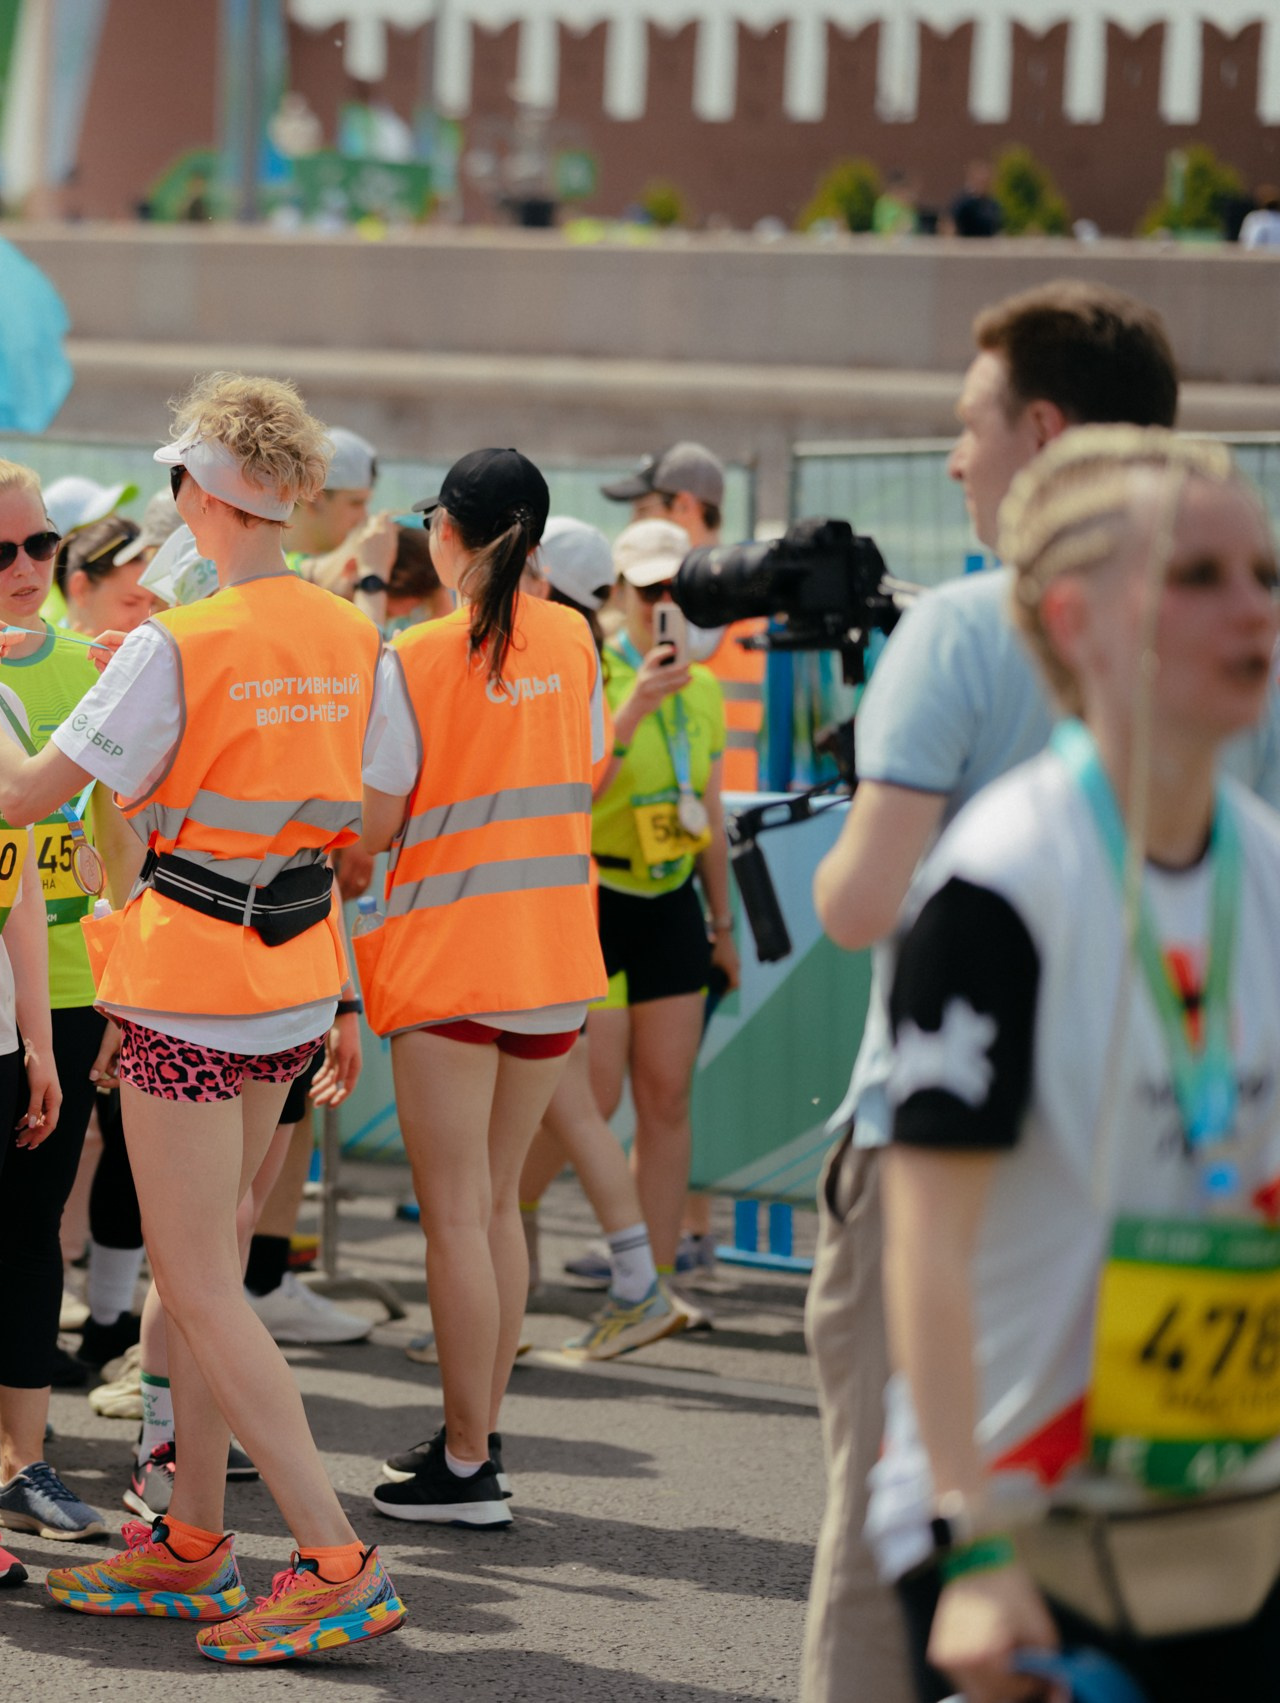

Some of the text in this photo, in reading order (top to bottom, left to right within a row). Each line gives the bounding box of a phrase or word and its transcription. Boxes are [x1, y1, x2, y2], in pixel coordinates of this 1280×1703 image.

[229, 673, 360, 700] СПОРТИВНЫЙ
[486, 674, 561, 707] Судья
[256, 701, 350, 726] ВОЛОНТЁР
[86, 728, 124, 758] СБЕР
